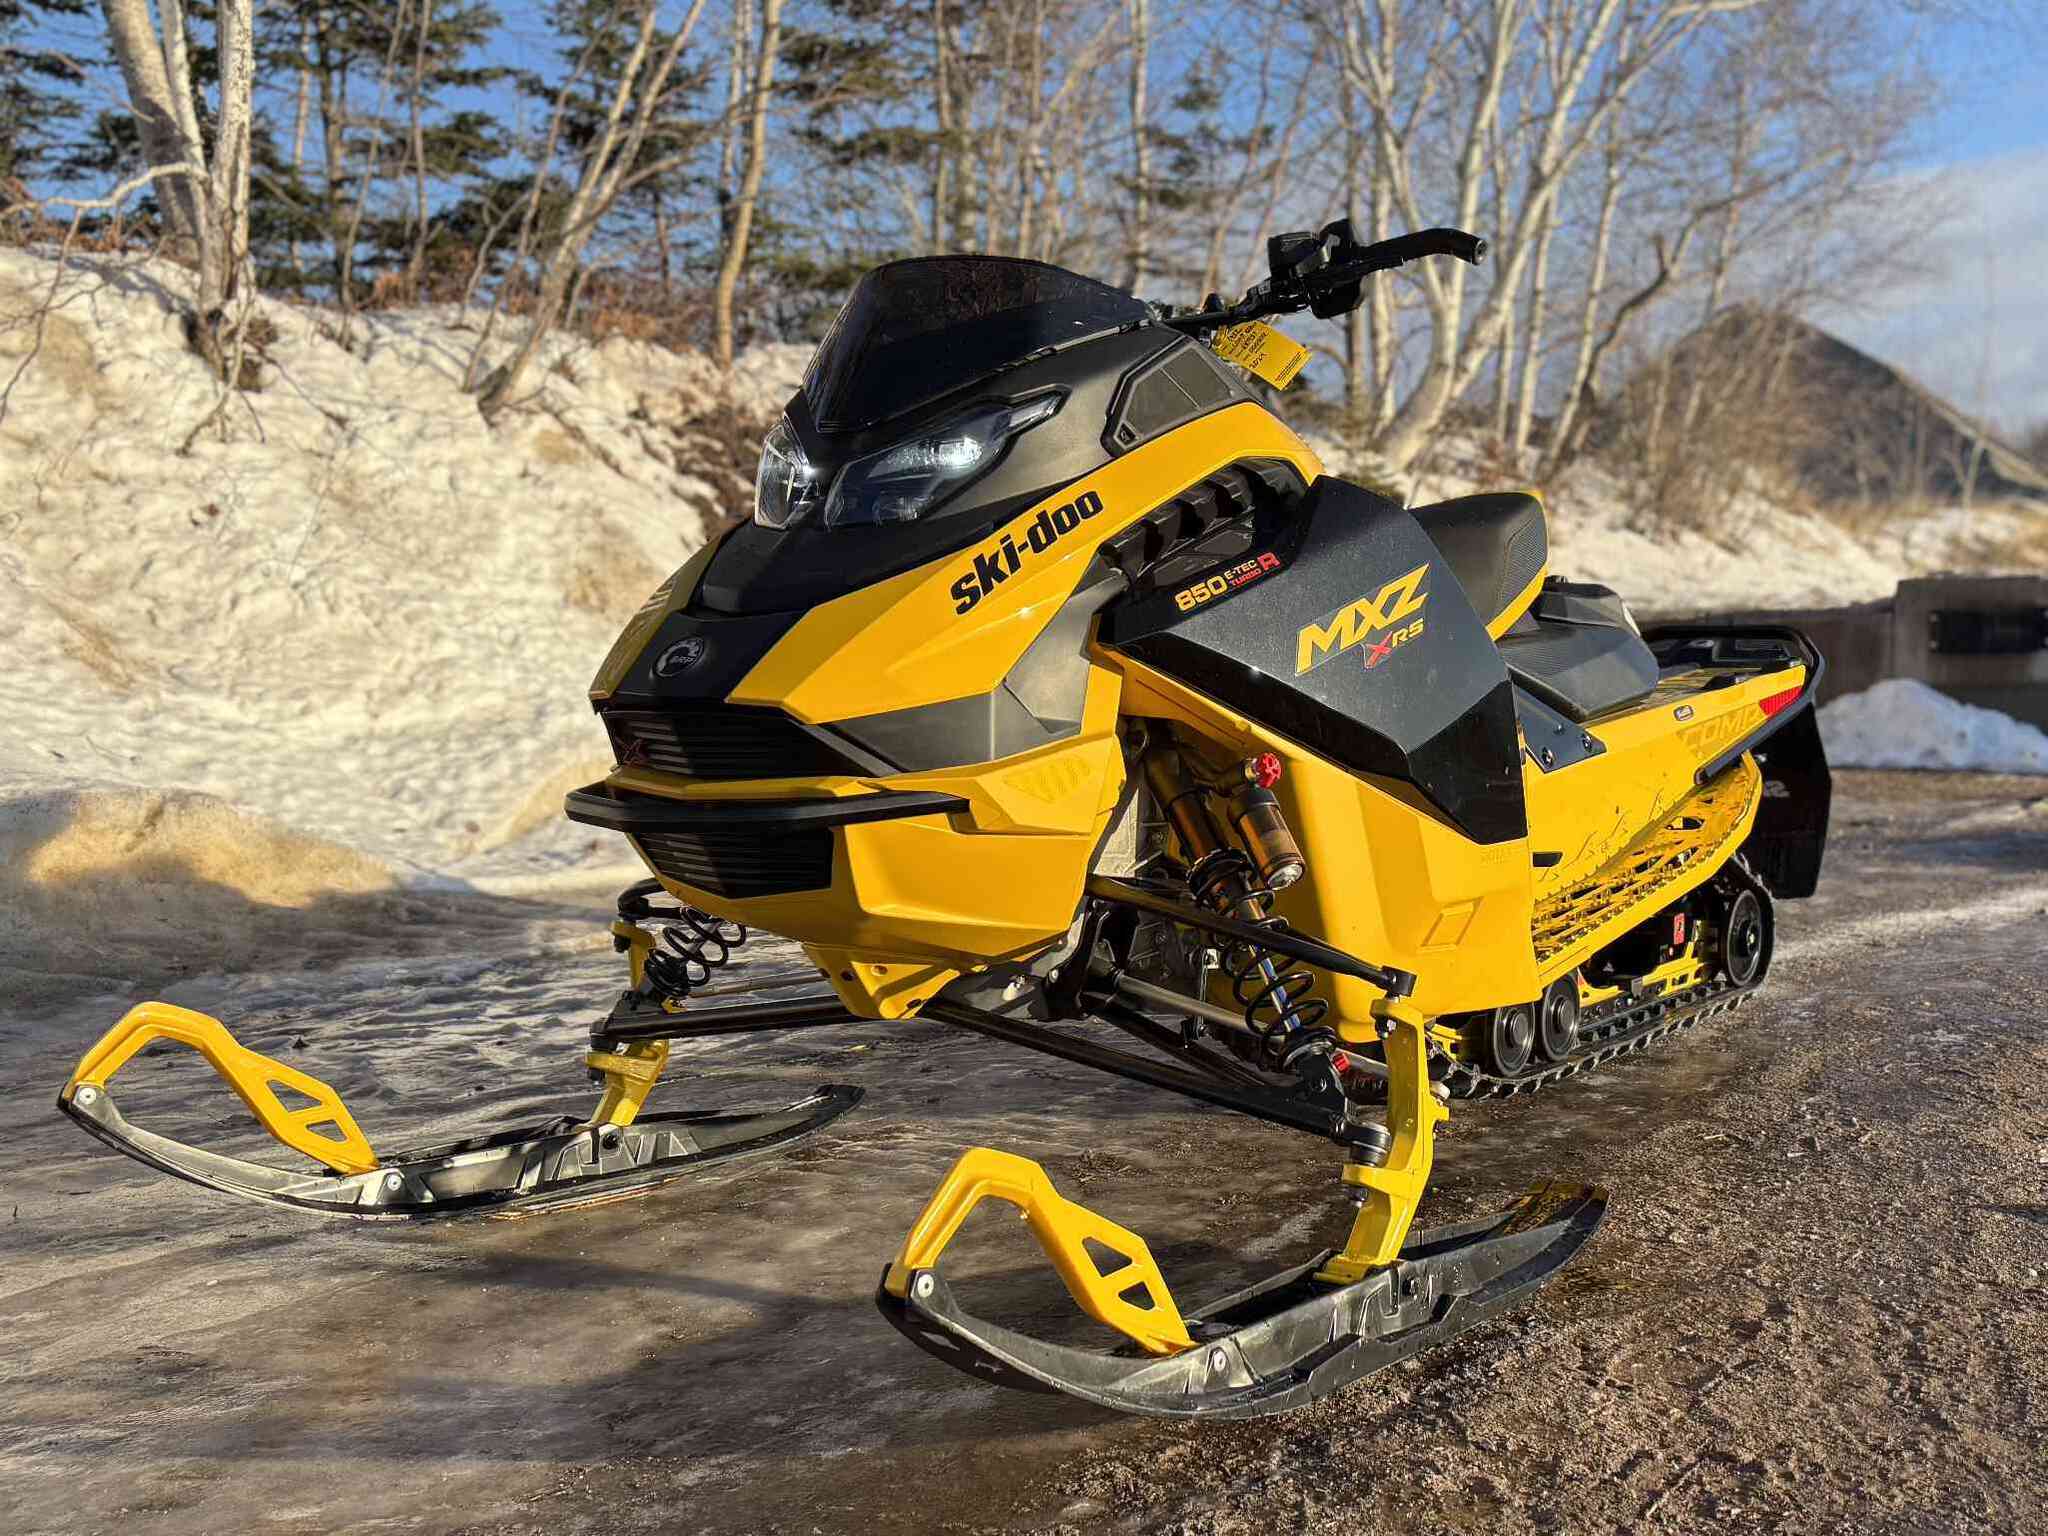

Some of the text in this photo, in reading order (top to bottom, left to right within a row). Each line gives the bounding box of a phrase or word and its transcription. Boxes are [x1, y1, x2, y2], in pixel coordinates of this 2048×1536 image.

[950, 490, 1104, 615] ski-doo
[1175, 552, 1281, 611] 850 E-TEC R
[1230, 568, 1263, 588] TURBO
[1296, 563, 1429, 676] MXZ
